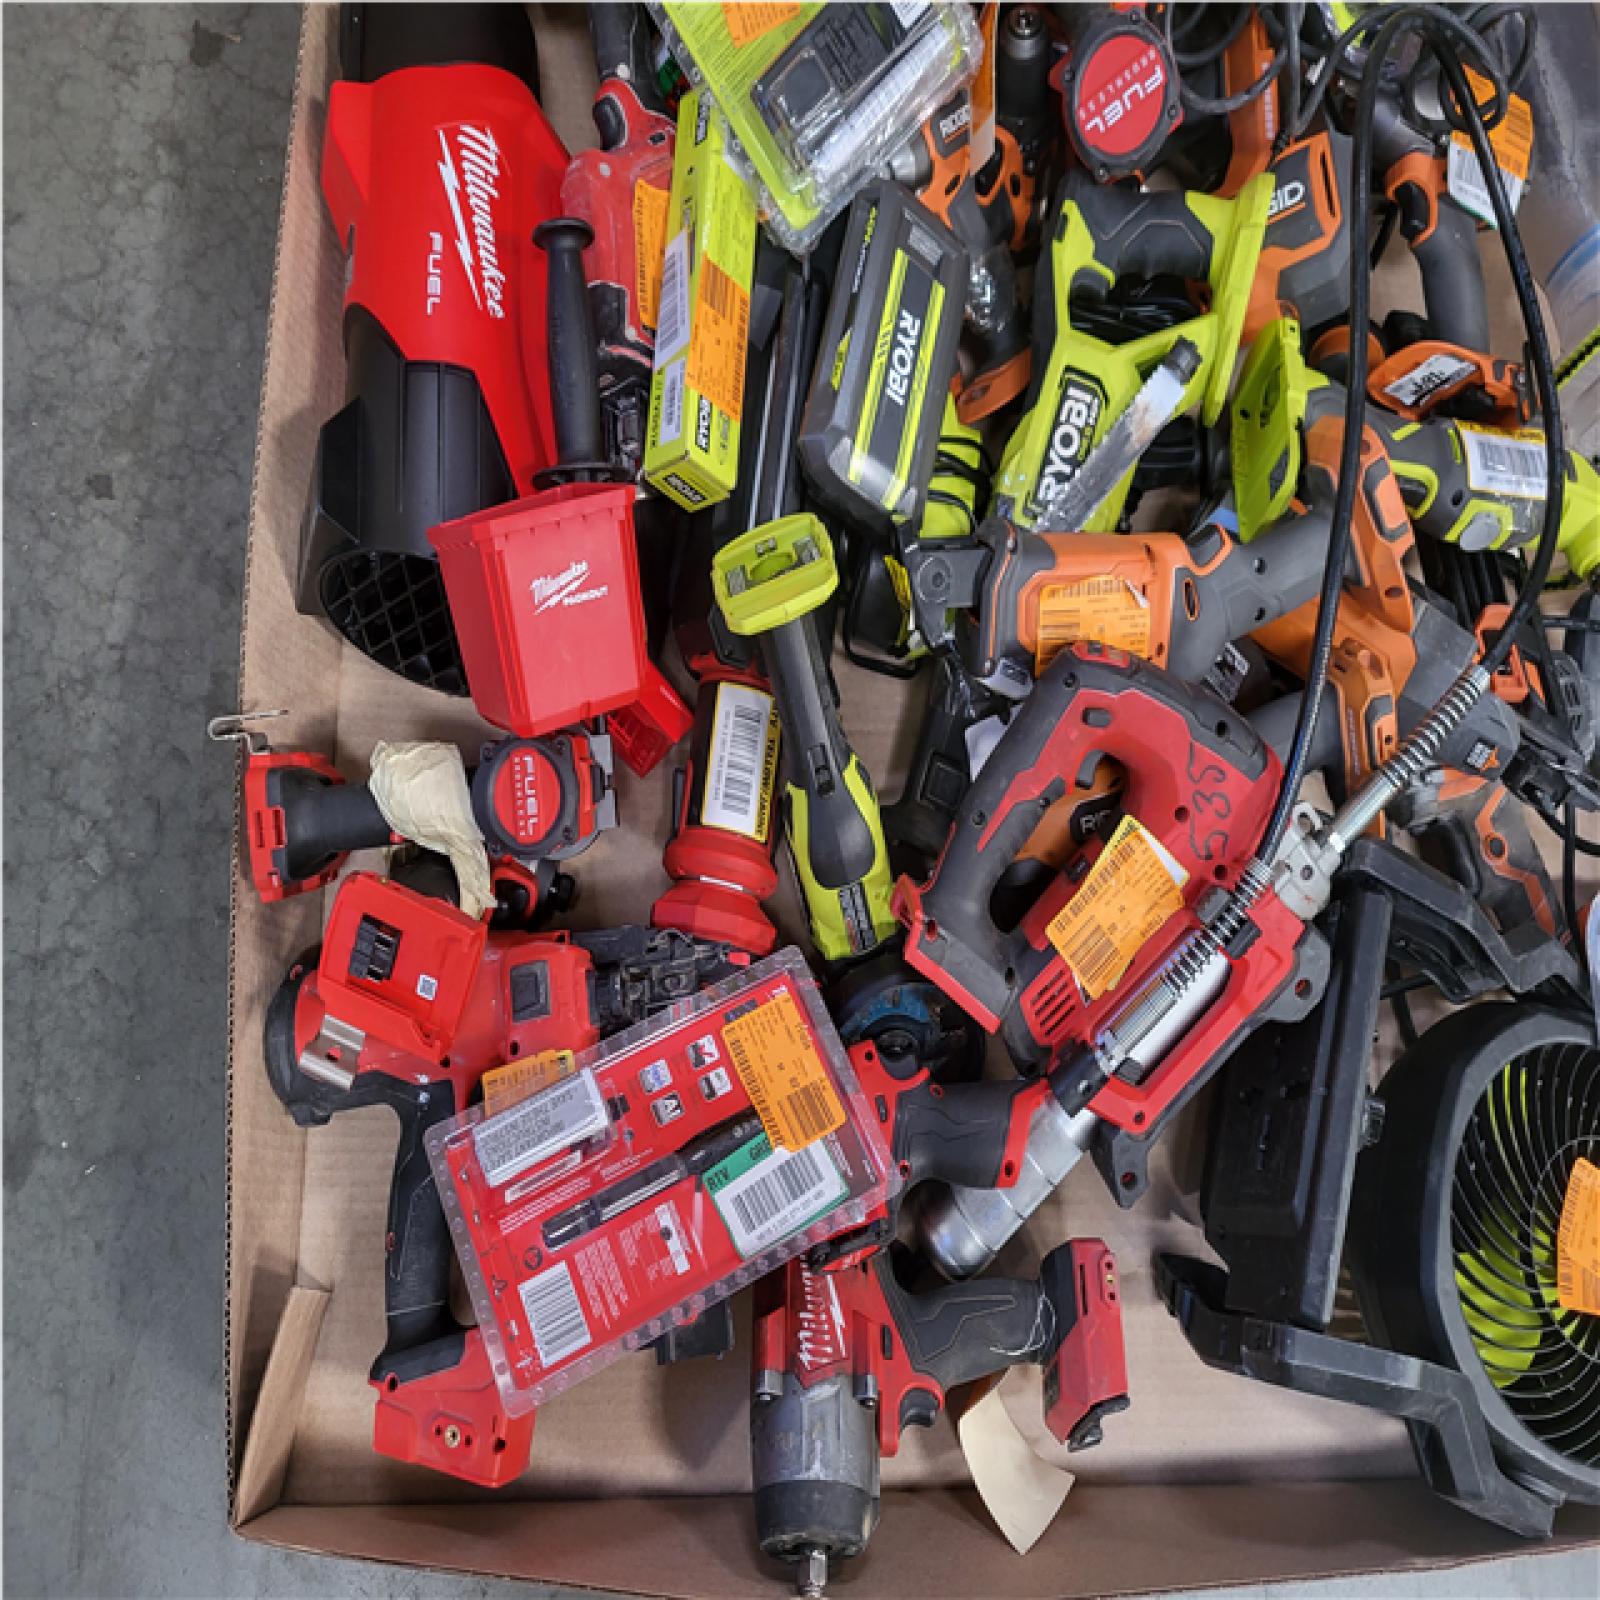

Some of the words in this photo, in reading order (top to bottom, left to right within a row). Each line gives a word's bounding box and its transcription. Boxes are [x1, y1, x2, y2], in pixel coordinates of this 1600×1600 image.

[1084, 64, 1163, 133] FUEL
[457, 124, 506, 319] Milwaukee
[427, 231, 443, 316] FUEL
[885, 309, 921, 406] RYOBI
[1037, 386, 1093, 502] RYOBI
[522, 754, 539, 836] FUEL
